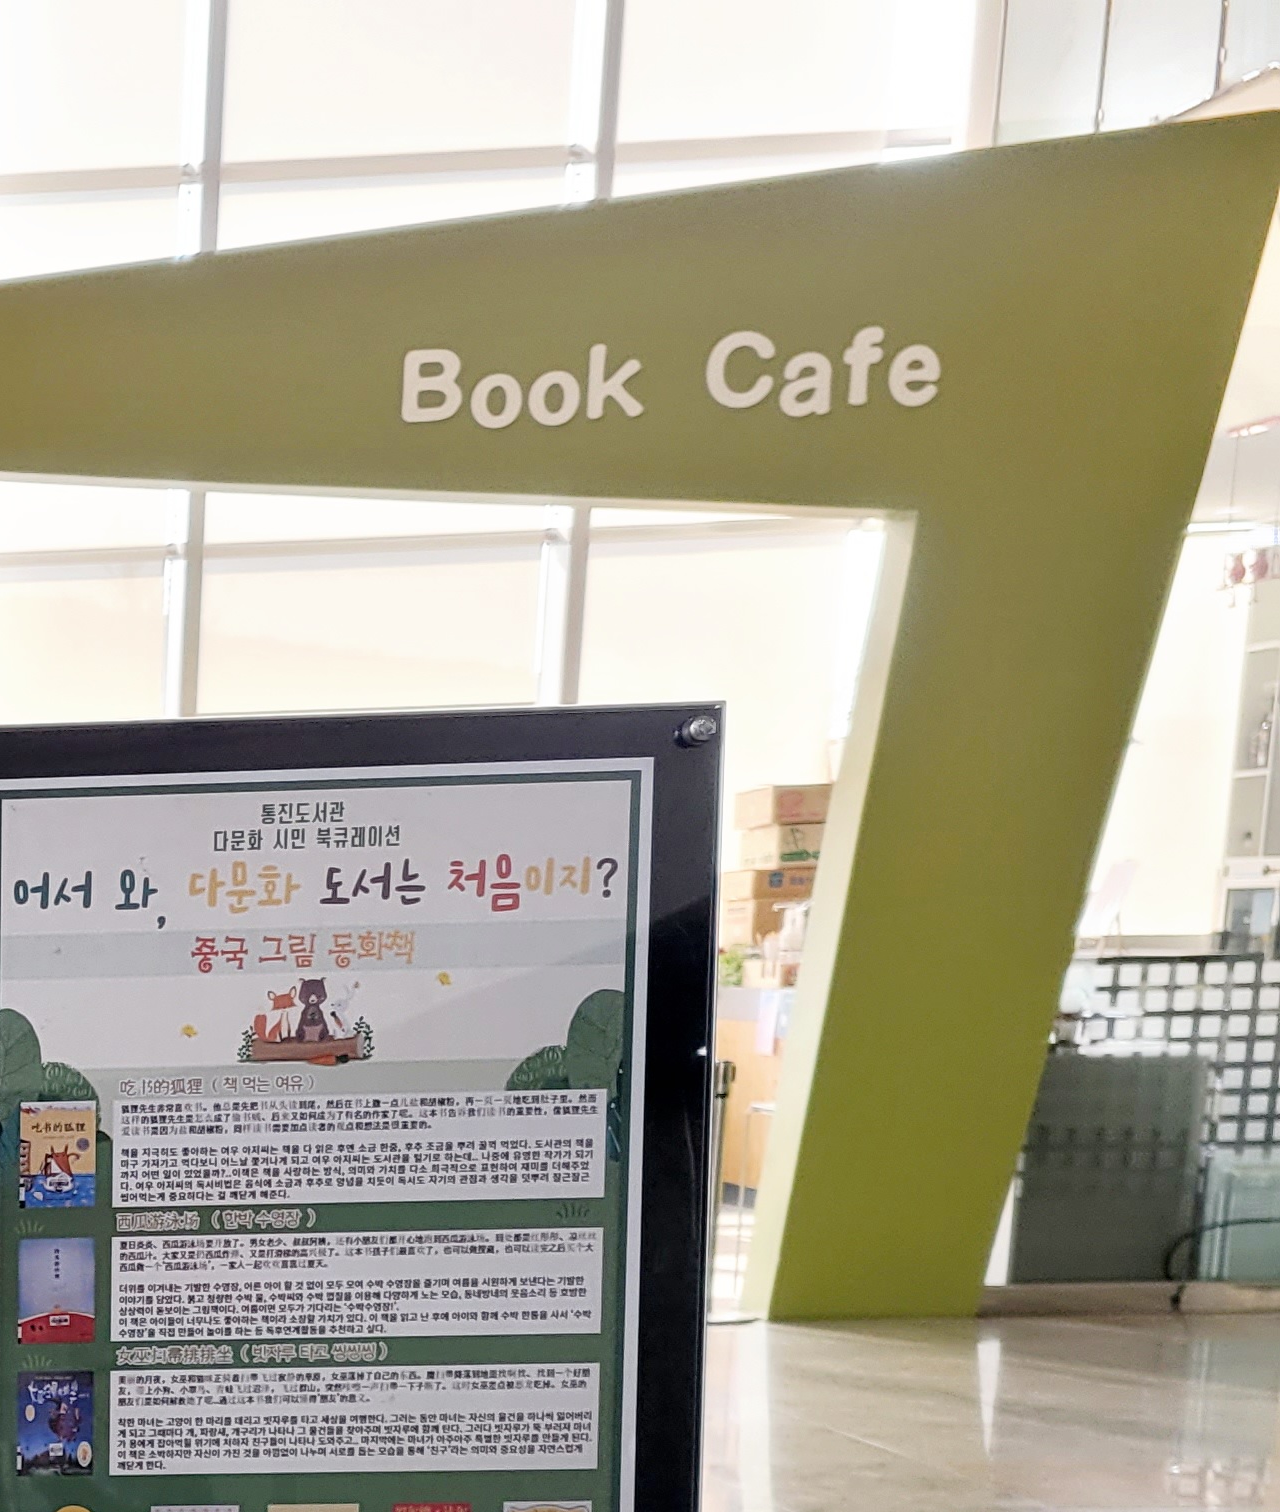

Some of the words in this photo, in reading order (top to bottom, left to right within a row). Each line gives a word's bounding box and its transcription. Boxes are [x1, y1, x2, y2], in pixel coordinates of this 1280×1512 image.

[401, 344, 644, 429] Book
[706, 326, 940, 417] Cafe
[260, 802, 345, 825] 통진도서관
[213, 828, 264, 852] 다문화
[274, 826, 308, 851] 시민
[317, 825, 401, 851] 북큐레이션
[14, 872, 92, 910] 어서
[114, 872, 167, 928] 와,
[188, 861, 301, 914] 다문화
[320, 860, 425, 906] 도서는
[448, 854, 619, 913] 처음이지?
[191, 934, 248, 973] 중국
[259, 933, 316, 968] 그림
[328, 929, 417, 965] 동화책
[243, 1076, 270, 1093] 먹는
